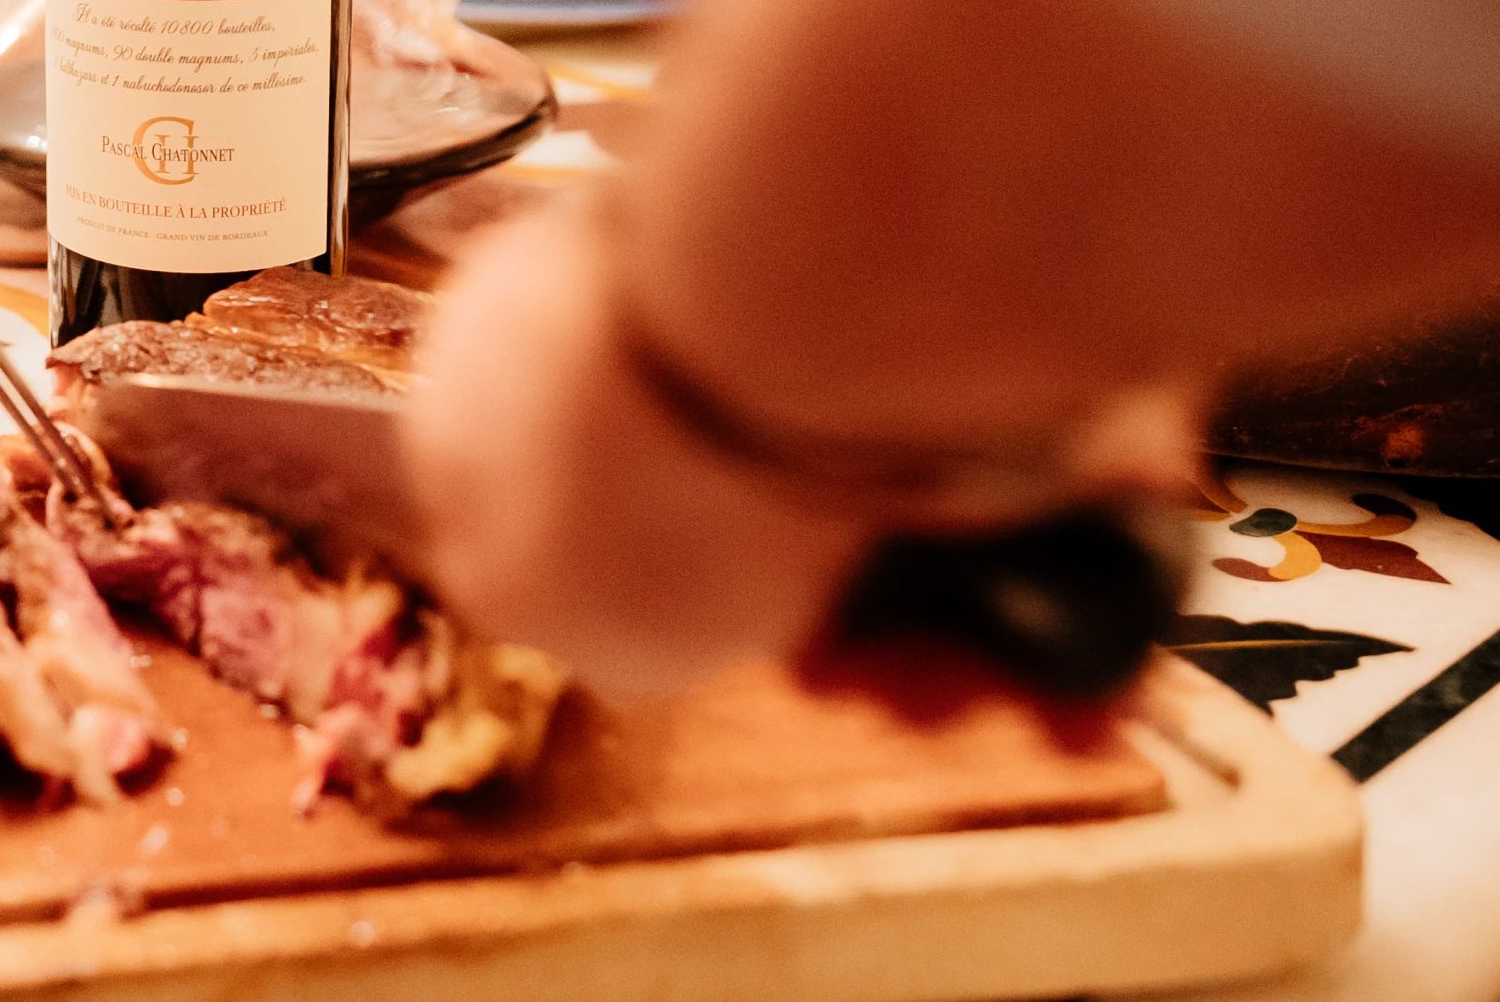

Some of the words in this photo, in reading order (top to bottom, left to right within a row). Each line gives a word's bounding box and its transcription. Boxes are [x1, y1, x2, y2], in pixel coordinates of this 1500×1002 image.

[217, 14, 275, 35] bouteilles,
[113, 44, 134, 62] 90
[135, 45, 174, 64] double
[178, 52, 244, 74] magnums,
[123, 74, 215, 94] nabuchodonosor
[219, 77, 233, 94] de
[237, 82, 249, 92] ce
[66, 184, 81, 200] MIS
[82, 191, 97, 206] EN
[99, 196, 173, 218] BOUTEILLE
[176, 203, 186, 219] À
[190, 207, 208, 219] LA
[212, 196, 286, 219] PROPRIÉTÉ
[118, 227, 150, 239] FRANCE
[156, 232, 188, 242] GRAND
[190, 234, 206, 242] VIN
[207, 234, 221, 242] DE
[222, 230, 269, 241] BORDEAUX
